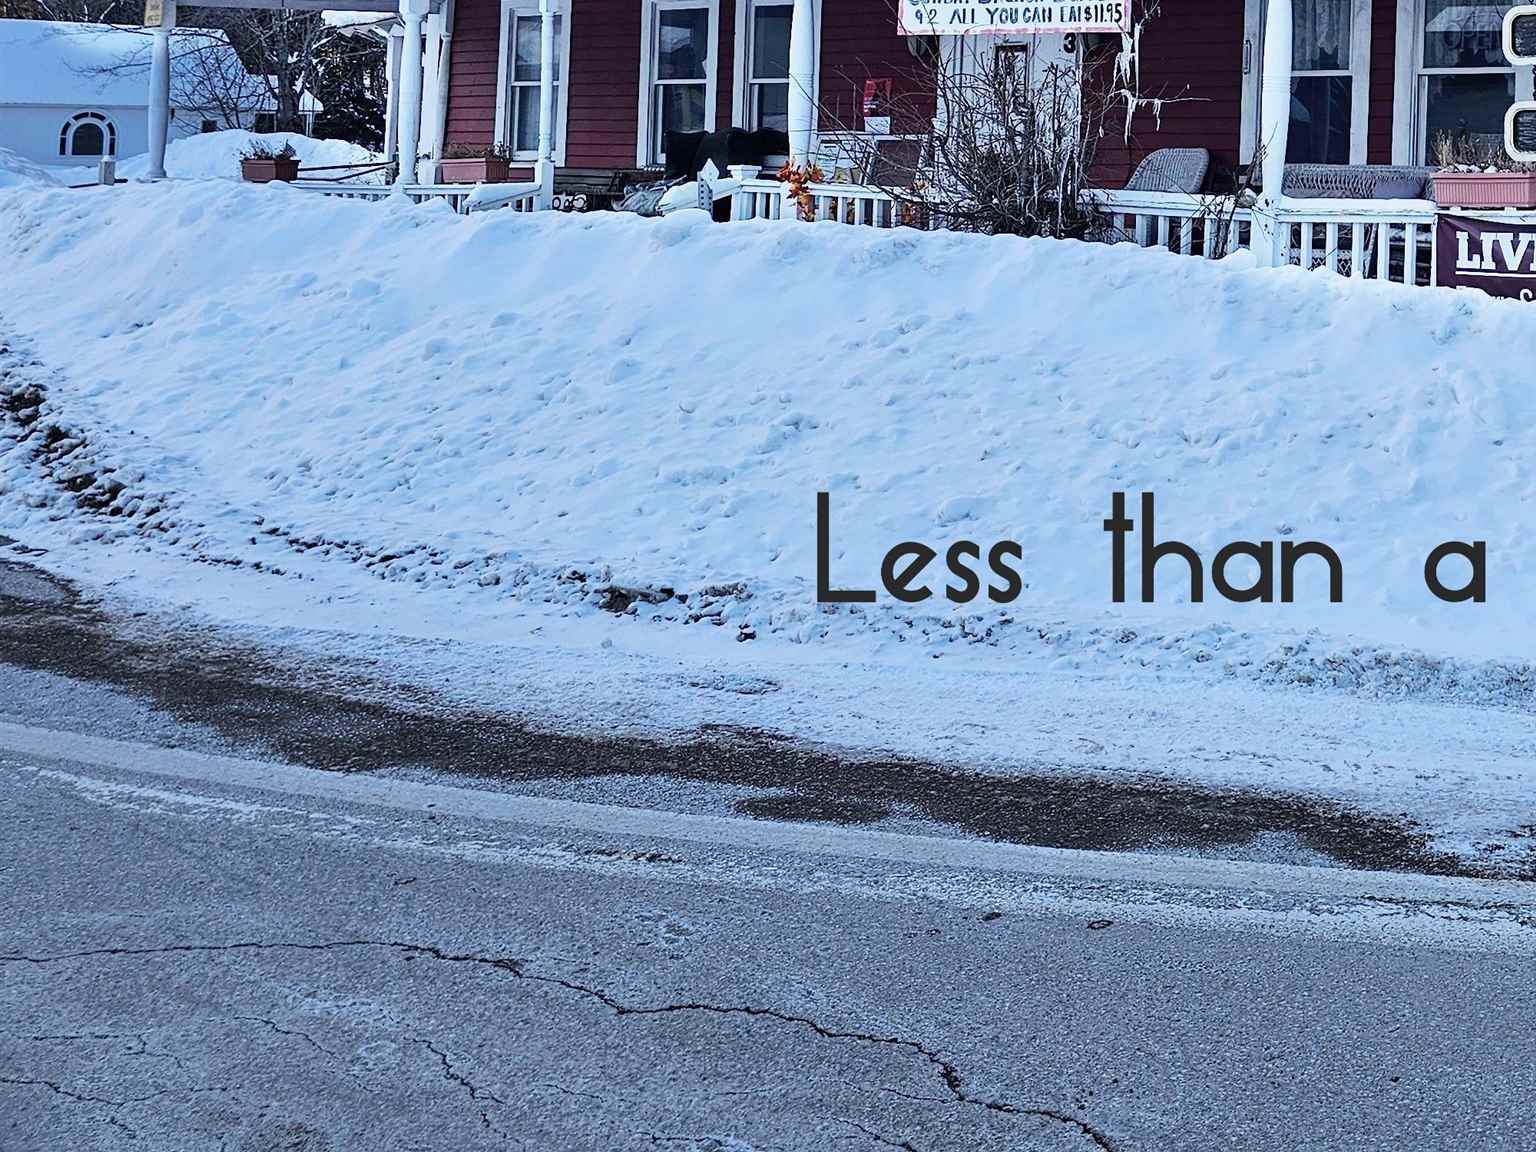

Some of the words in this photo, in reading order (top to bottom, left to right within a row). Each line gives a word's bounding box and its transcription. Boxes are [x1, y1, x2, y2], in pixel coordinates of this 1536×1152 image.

[986, 7, 1018, 24] YOU
[1023, 6, 1052, 23] CAN
[1084, 2, 1122, 23] $11.95
